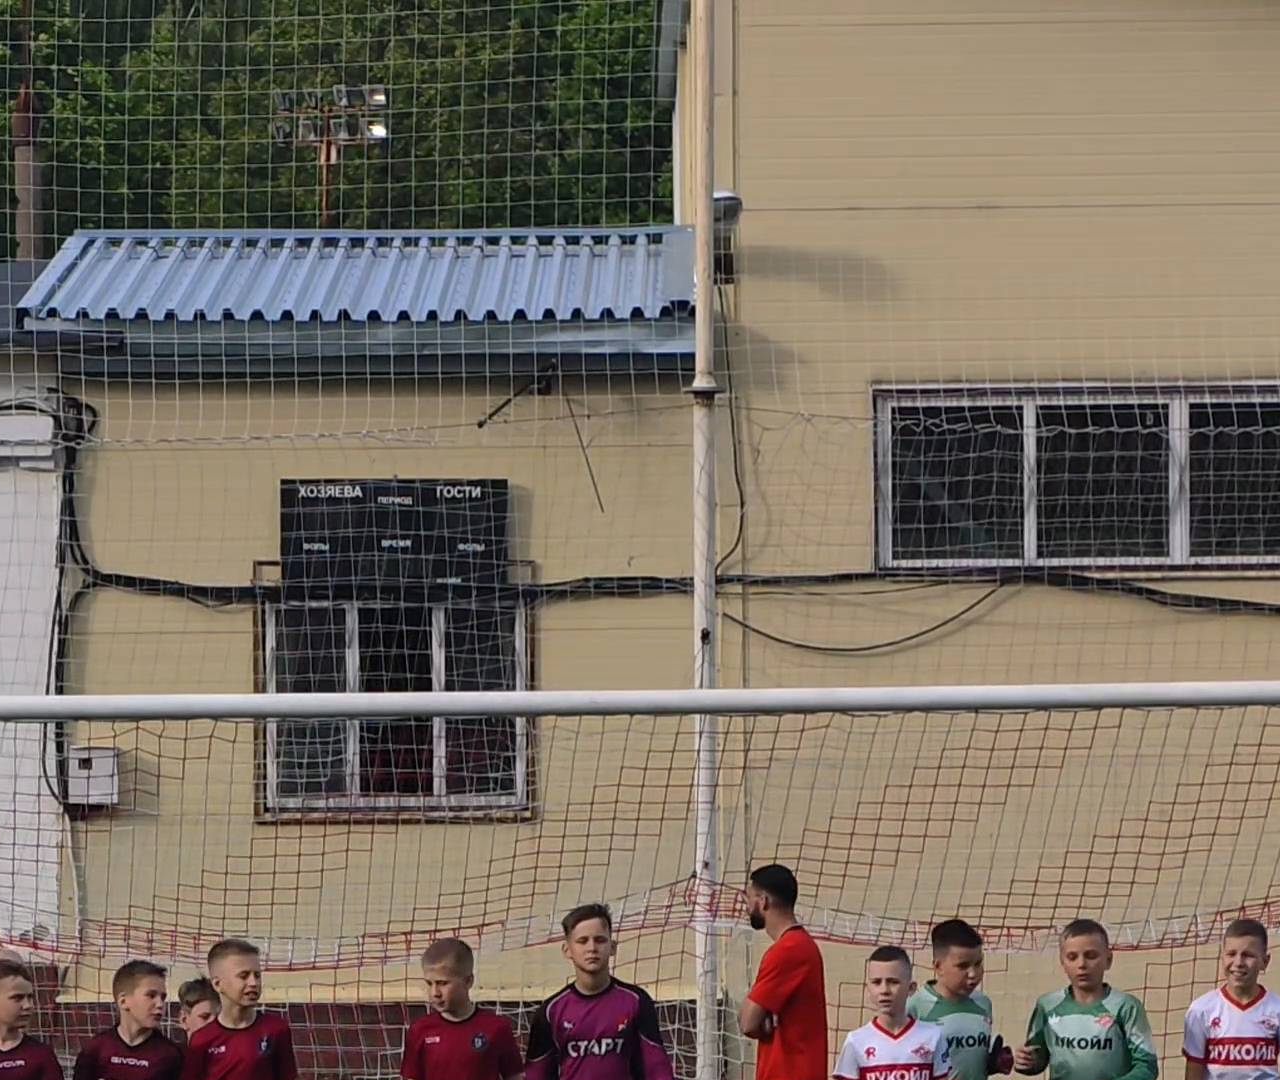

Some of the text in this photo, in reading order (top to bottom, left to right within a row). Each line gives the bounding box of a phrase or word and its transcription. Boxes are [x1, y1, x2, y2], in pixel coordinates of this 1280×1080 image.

[298, 485, 363, 498] ХОЗЯЕВА
[436, 485, 481, 498] ГОСТИ
[377, 496, 413, 505] ПЕРИОД
[945, 1032, 991, 1049] УКОЙ
[567, 1037, 625, 1058] СТАРТ
